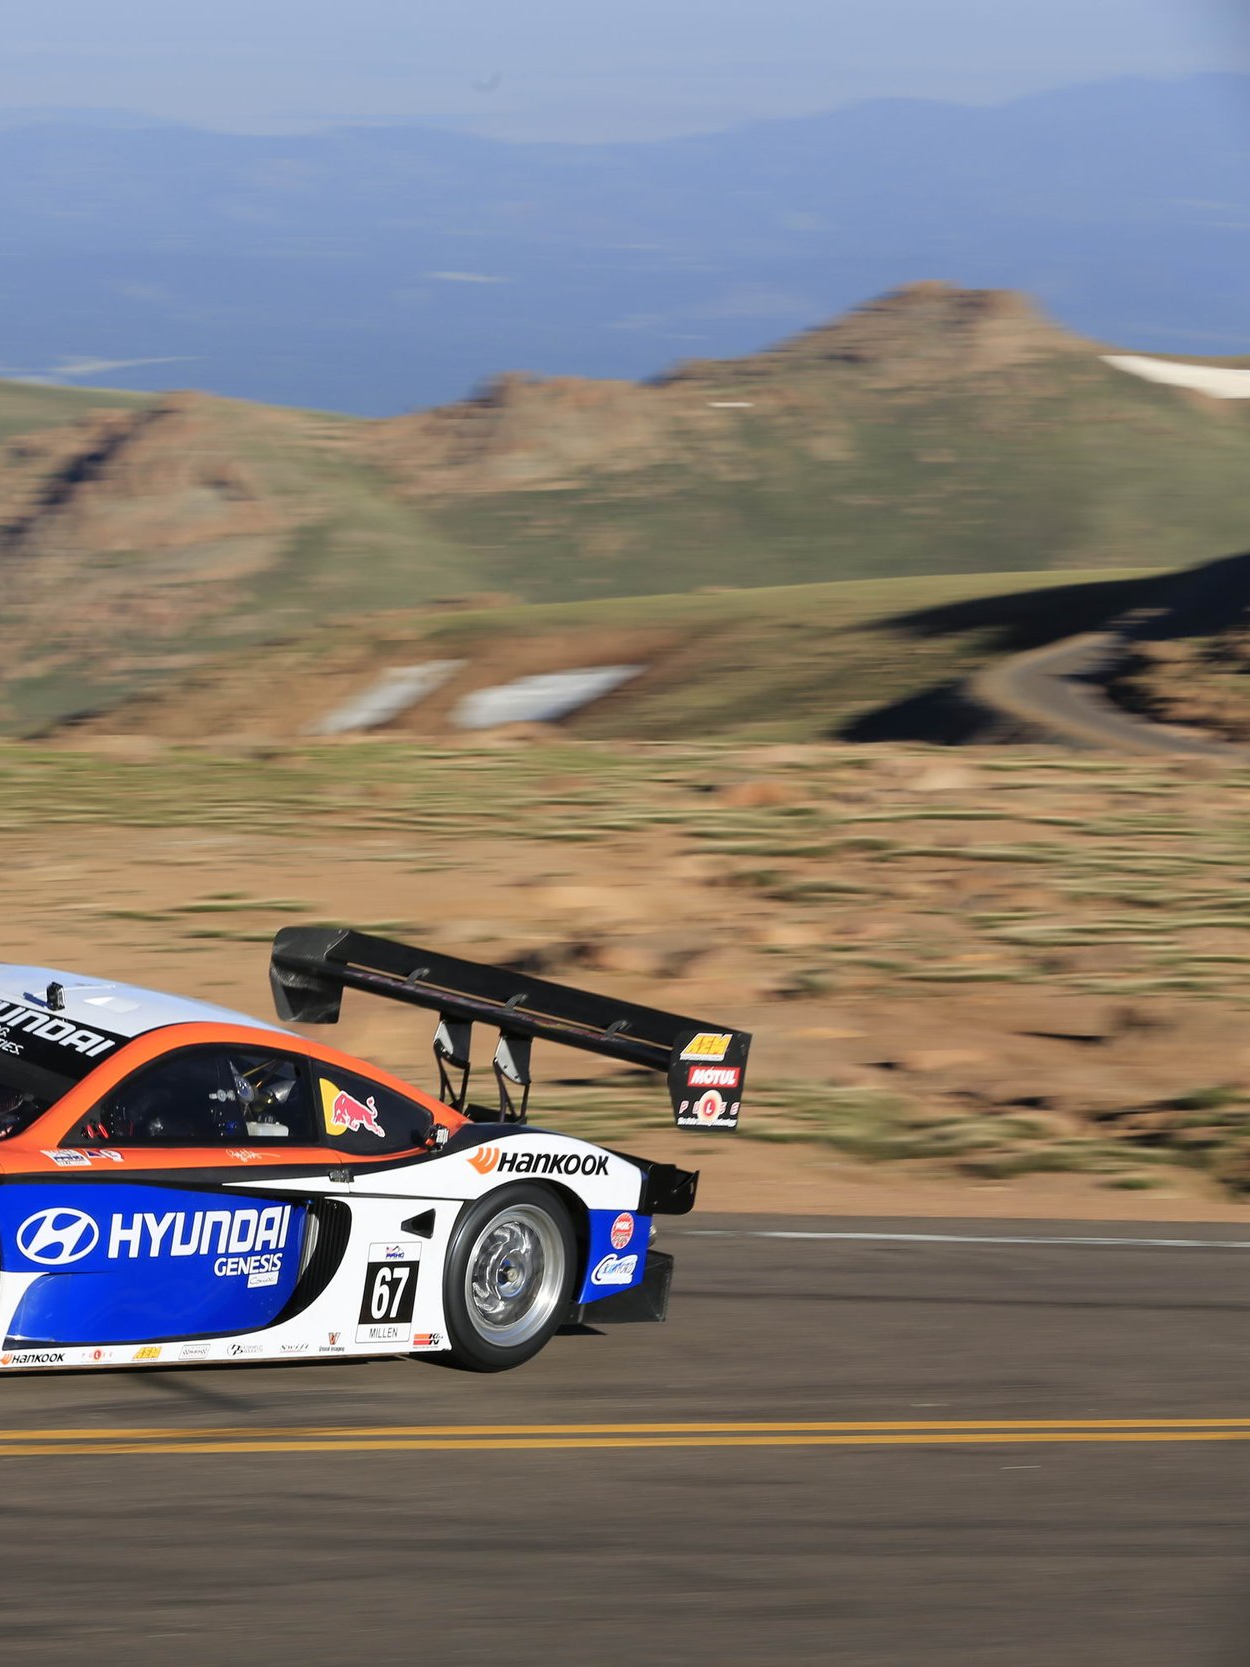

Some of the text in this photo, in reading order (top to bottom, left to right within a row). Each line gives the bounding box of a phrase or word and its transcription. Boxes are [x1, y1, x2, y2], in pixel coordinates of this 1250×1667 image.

[681, 1034, 733, 1054] AEM
[108, 1205, 291, 1258] HYUNDAI
[214, 1253, 283, 1276] GENESIS
[371, 1267, 410, 1320] 67
[369, 1327, 399, 1339] MILLEN
